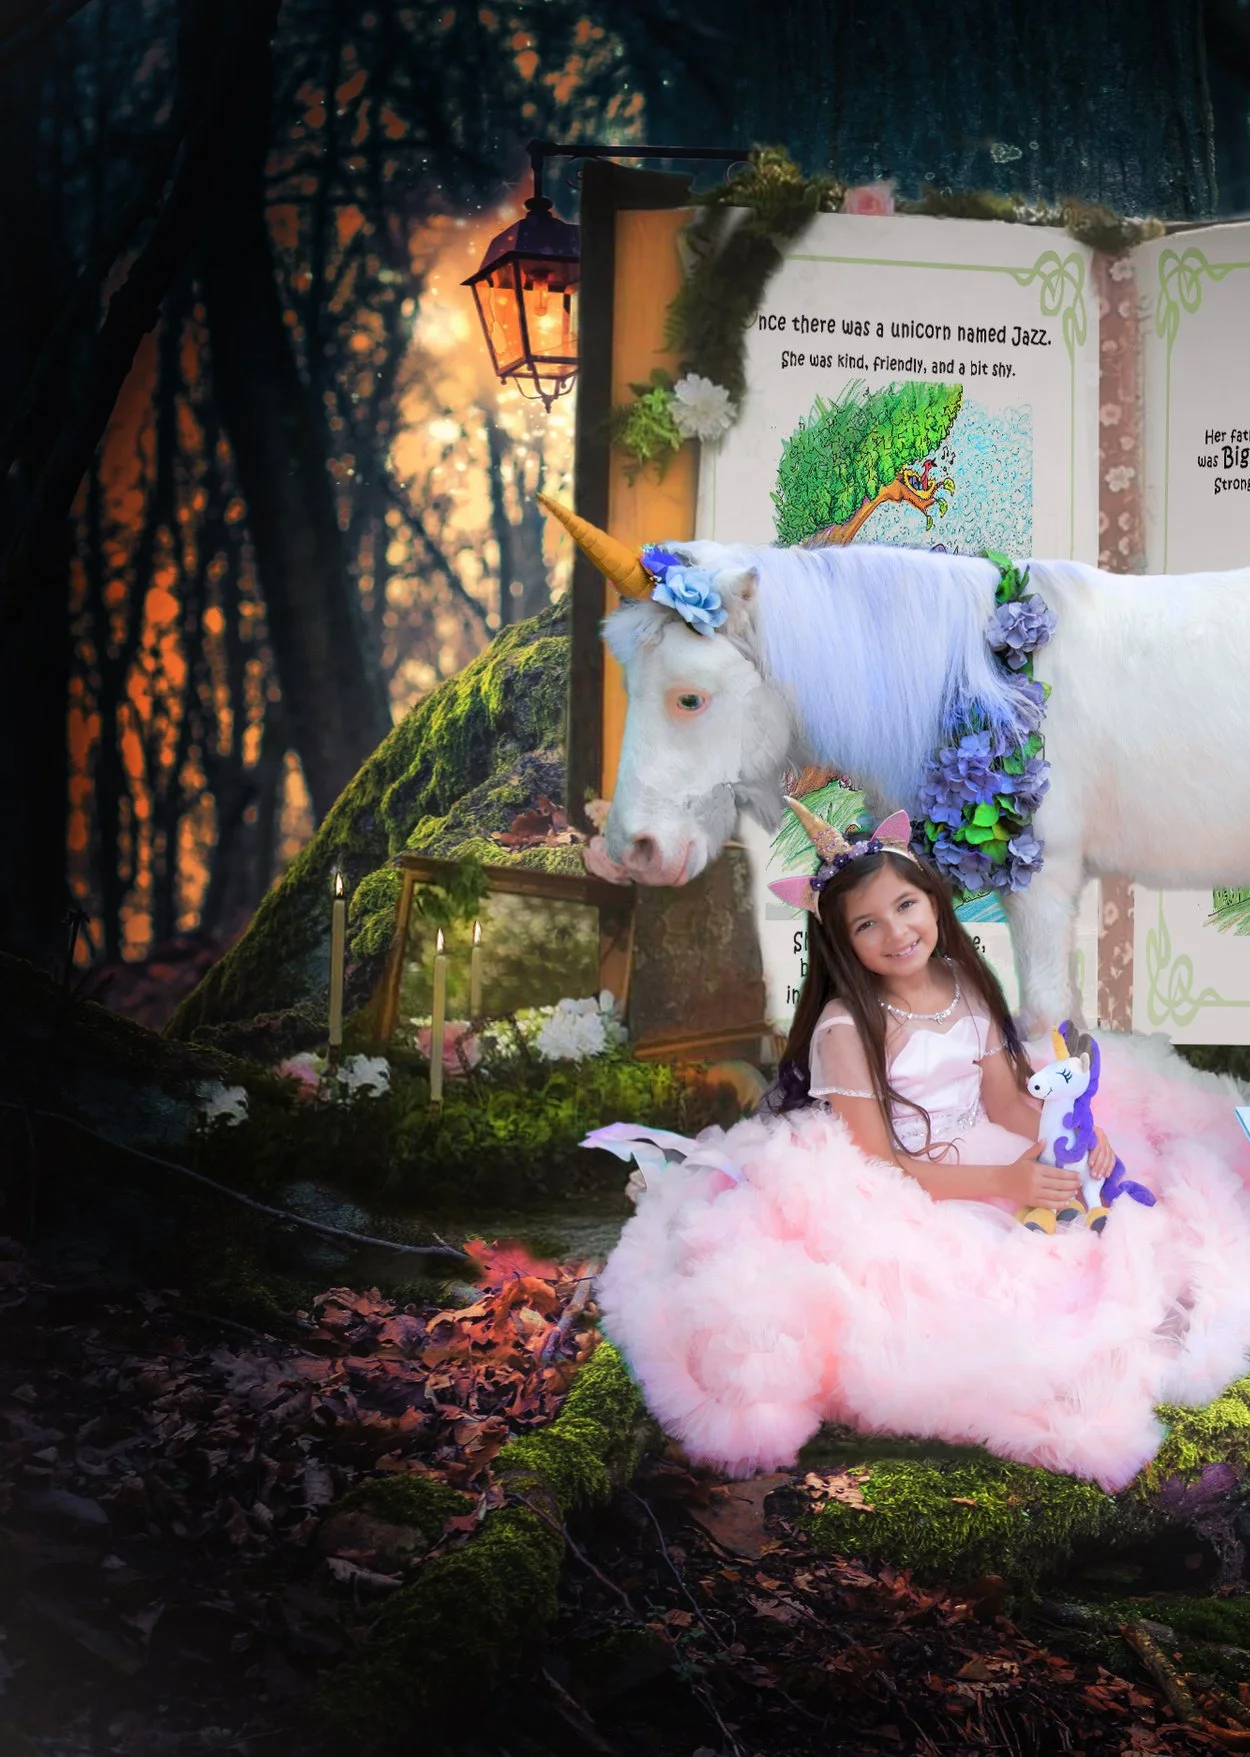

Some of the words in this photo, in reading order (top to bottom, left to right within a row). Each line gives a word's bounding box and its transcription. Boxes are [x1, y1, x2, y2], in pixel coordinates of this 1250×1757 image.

[791, 314, 836, 334] there
[841, 319, 871, 337] was
[875, 322, 884, 338] a
[890, 319, 951, 341] unicorn
[957, 325, 1007, 344] named
[1011, 326, 1052, 347] Jazz.
[781, 350, 806, 370] She
[809, 354, 833, 369] was
[837, 353, 869, 371] kind,
[873, 355, 927, 374] friendly,
[931, 359, 955, 375] and
[958, 362, 966, 376] a
[970, 360, 989, 377] bit
[991, 361, 1016, 379] shy.
[1204, 428, 1227, 445] Her
[1197, 454, 1219, 468] was
[1221, 445, 1250, 470] Big
